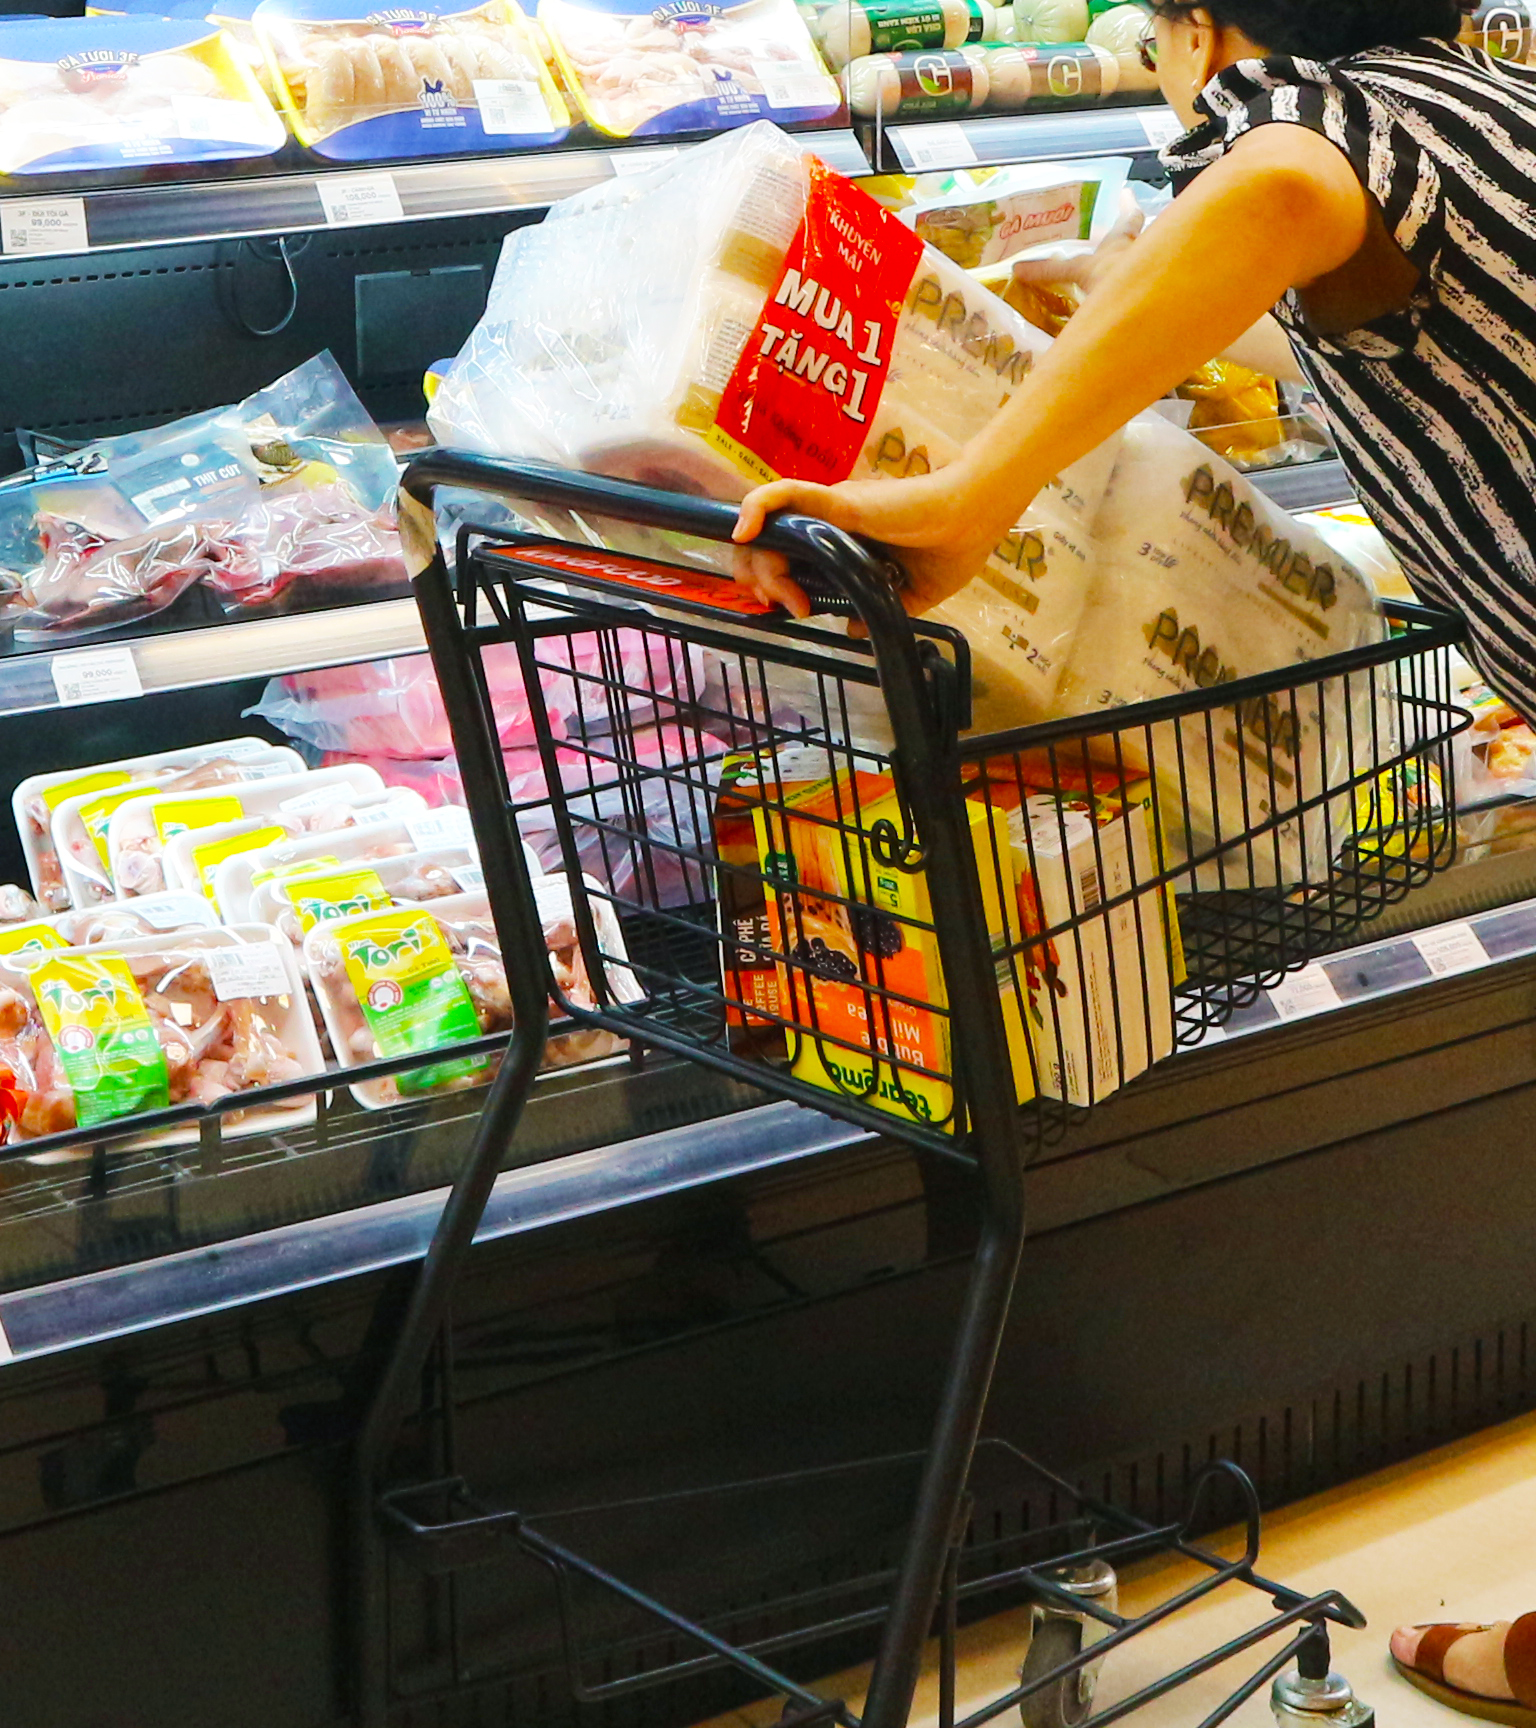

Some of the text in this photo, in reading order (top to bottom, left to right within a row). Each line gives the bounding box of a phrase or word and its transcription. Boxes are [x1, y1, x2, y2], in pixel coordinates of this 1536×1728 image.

[829, 209, 884, 266] KHUYẾN
[774, 269, 861, 353] MUA
[856, 318, 883, 368] 1
[759, 320, 849, 399] TẶNG
[841, 370, 871, 425] 1
[1185, 463, 1337, 613] PREMIER
[349, 930, 422, 967] Tori
